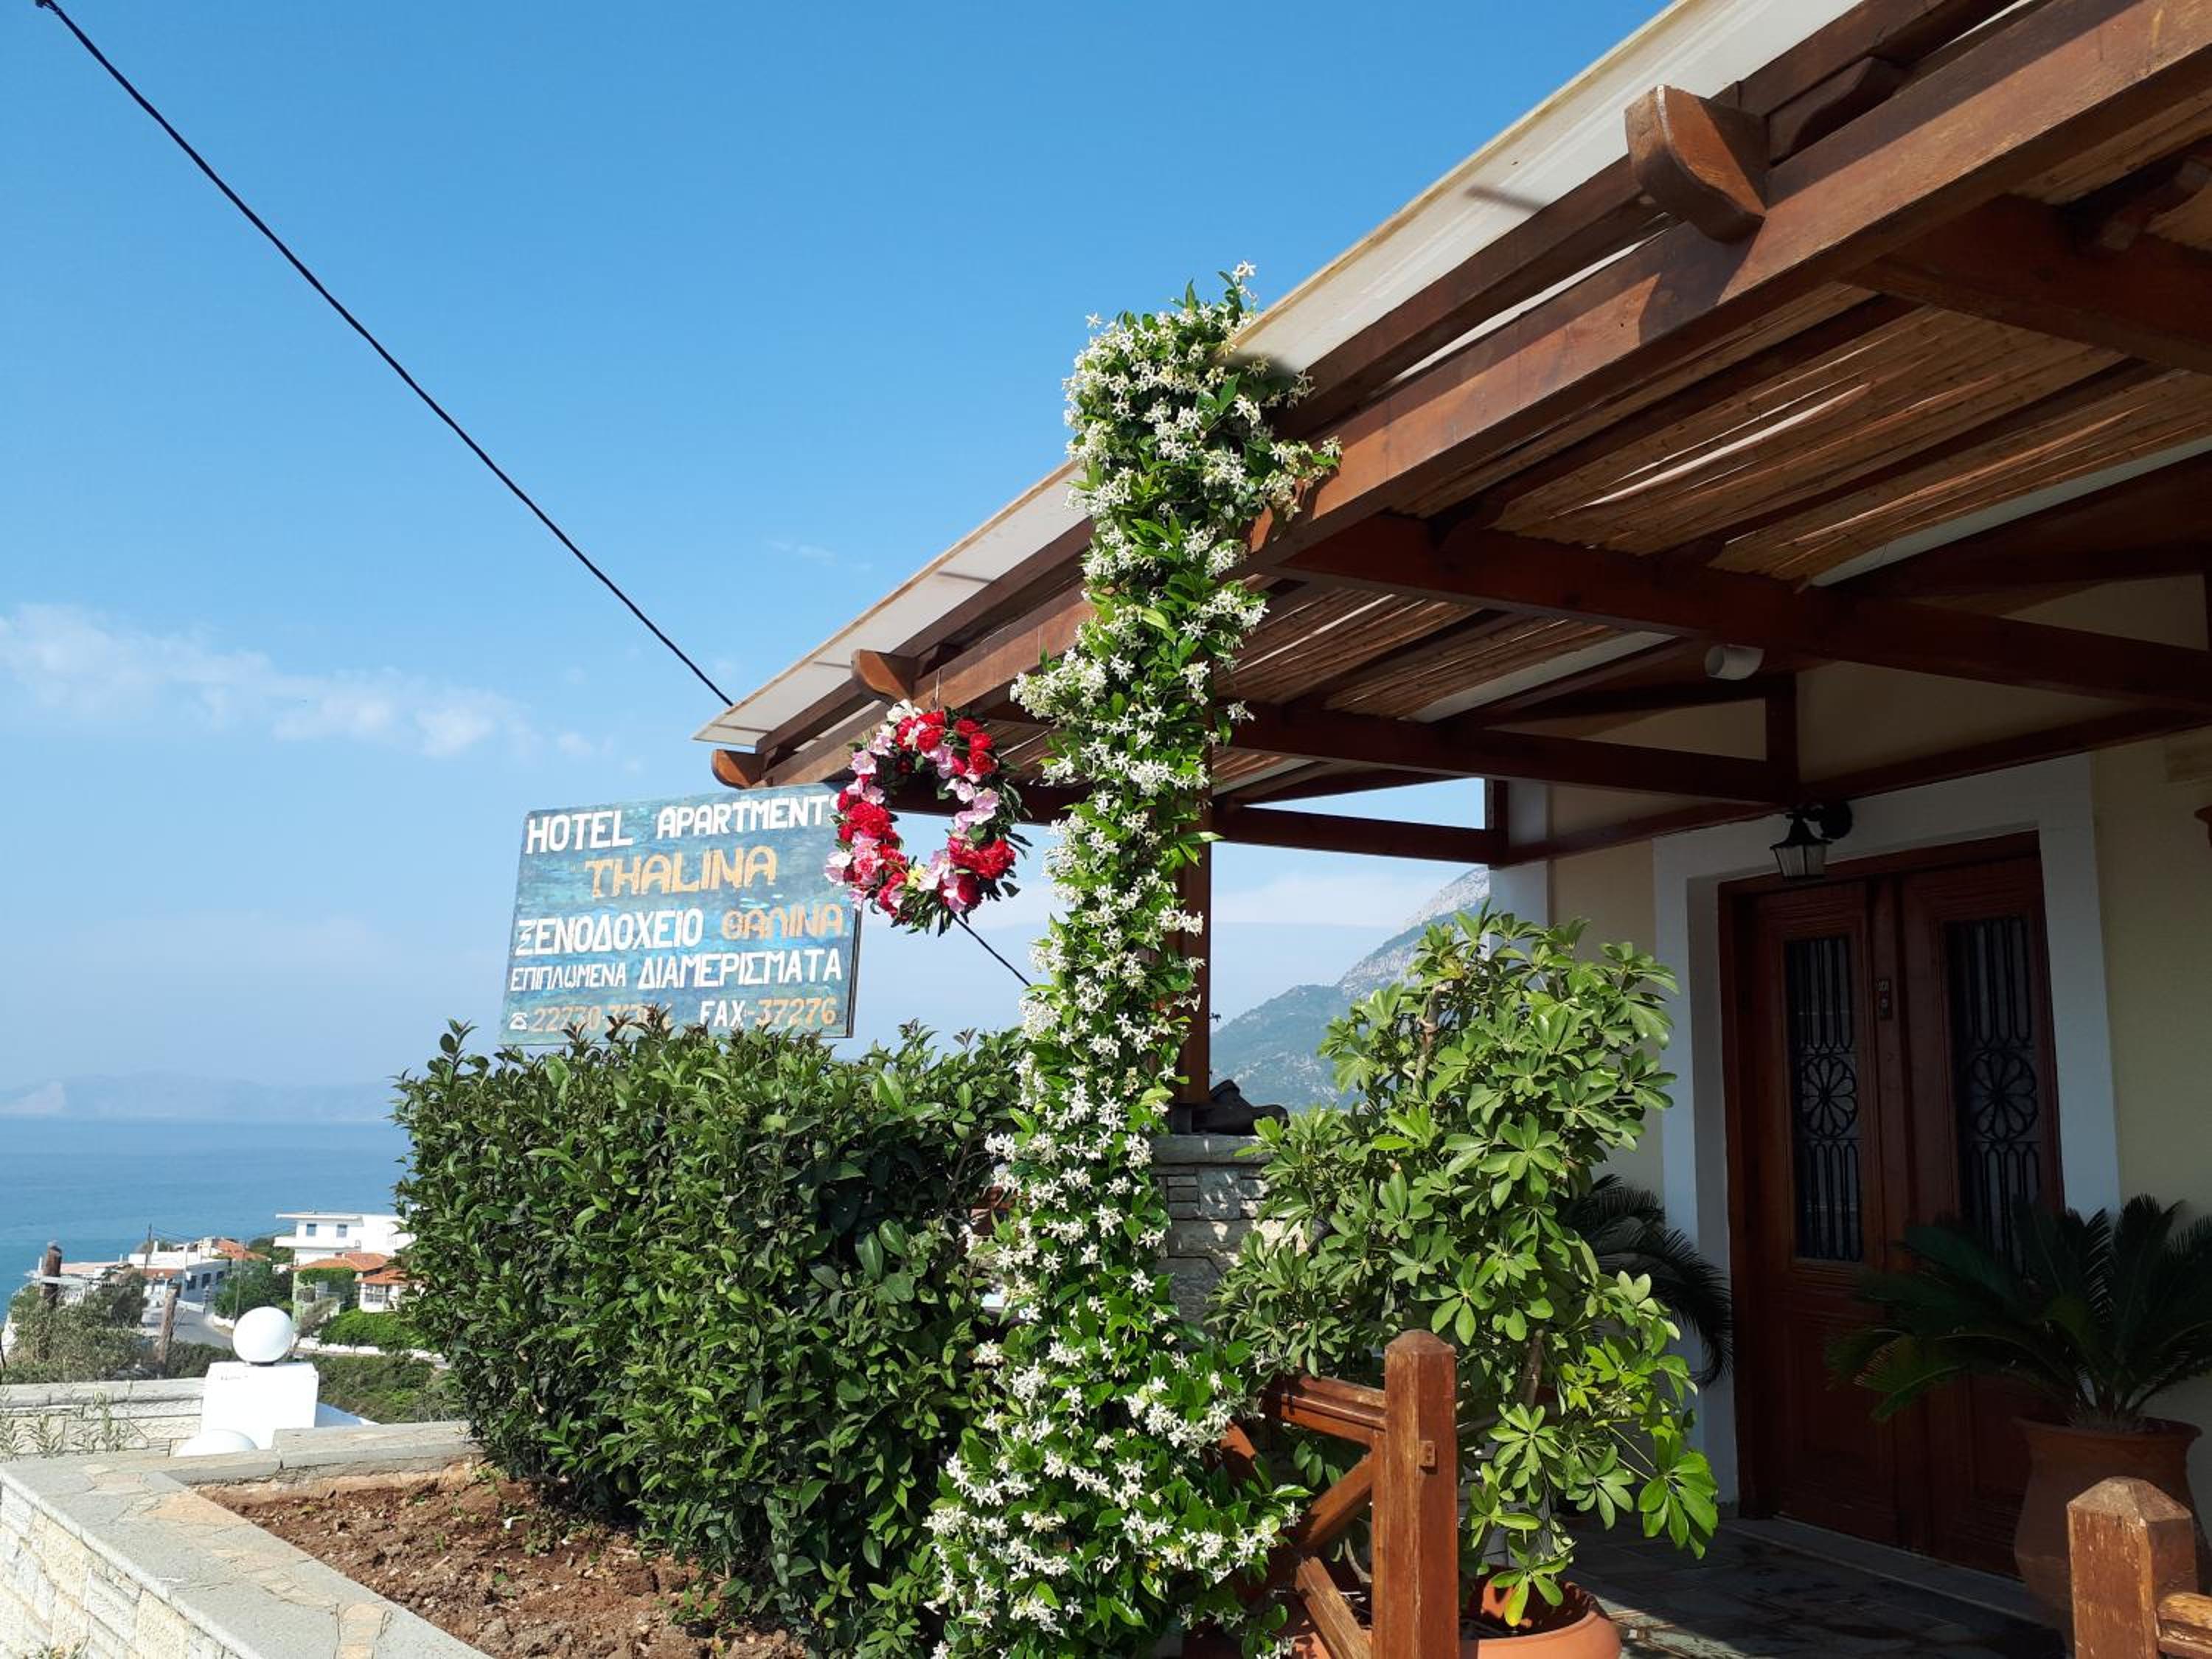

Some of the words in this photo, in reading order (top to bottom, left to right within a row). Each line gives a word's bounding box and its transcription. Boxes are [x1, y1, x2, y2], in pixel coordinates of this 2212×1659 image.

[526, 810, 633, 855] HOTEL
[585, 846, 778, 897] THALINA
[515, 908, 704, 956] ΞΕΝΟΔΟΧΕΙΟ
[637, 947, 843, 990] ΔΙΑΜΕΡΙΣΜΑΤΑ
